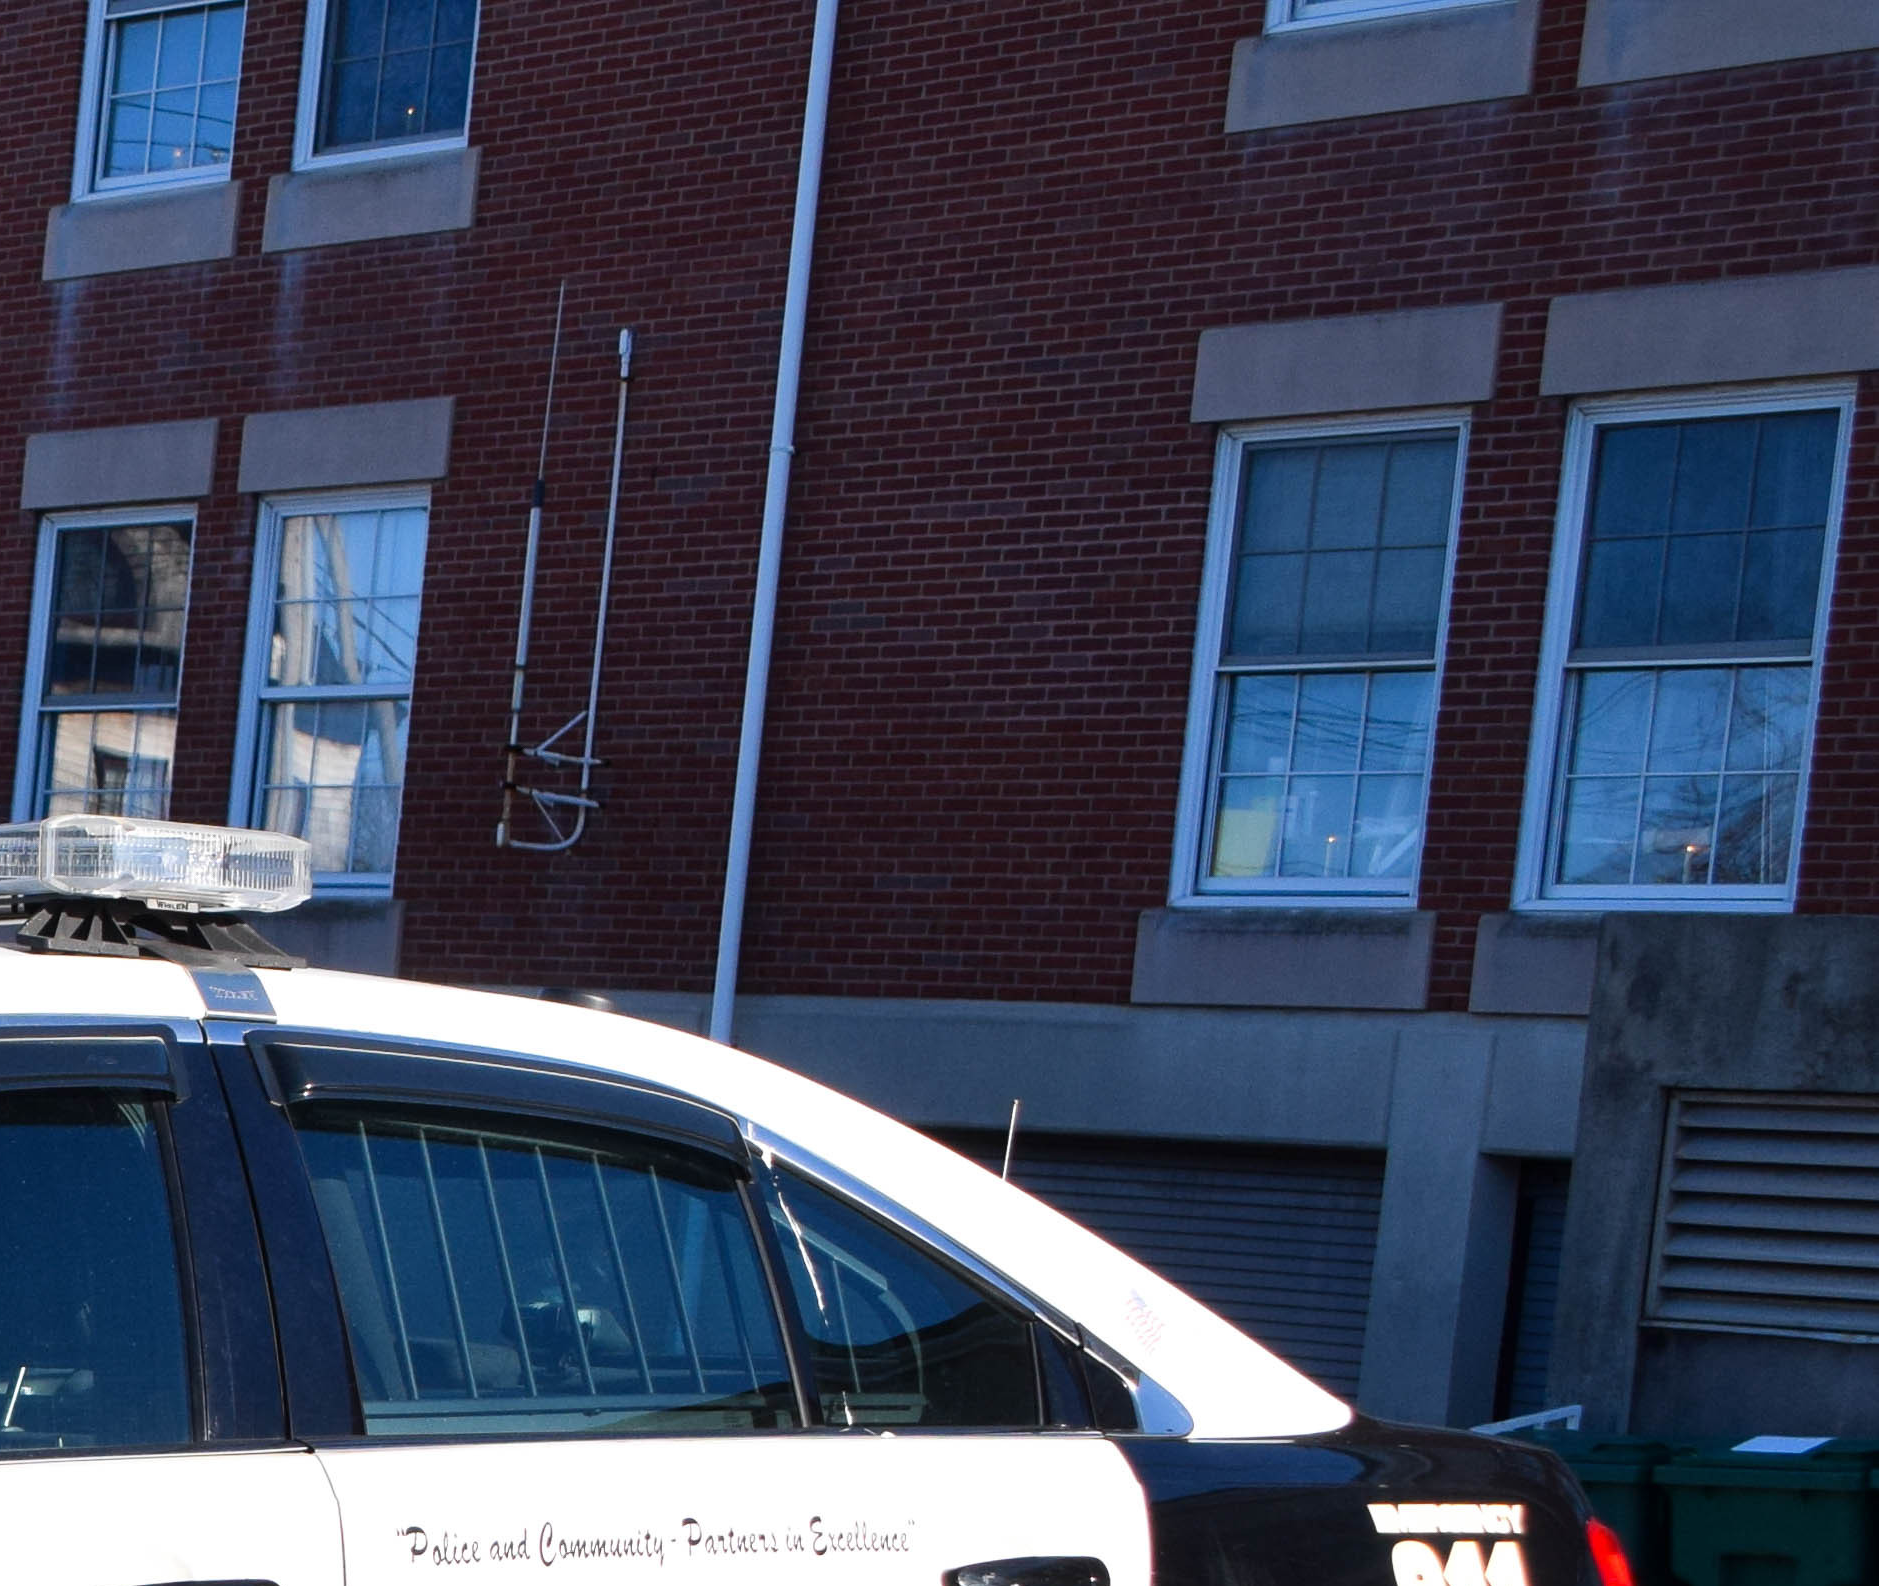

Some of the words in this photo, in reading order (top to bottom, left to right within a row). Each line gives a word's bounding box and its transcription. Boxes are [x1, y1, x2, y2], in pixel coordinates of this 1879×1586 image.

[490, 1528, 531, 1562] and
[540, 1521, 664, 1567] Community
[681, 1517, 779, 1557] Partners
[785, 1527, 805, 1552] in
